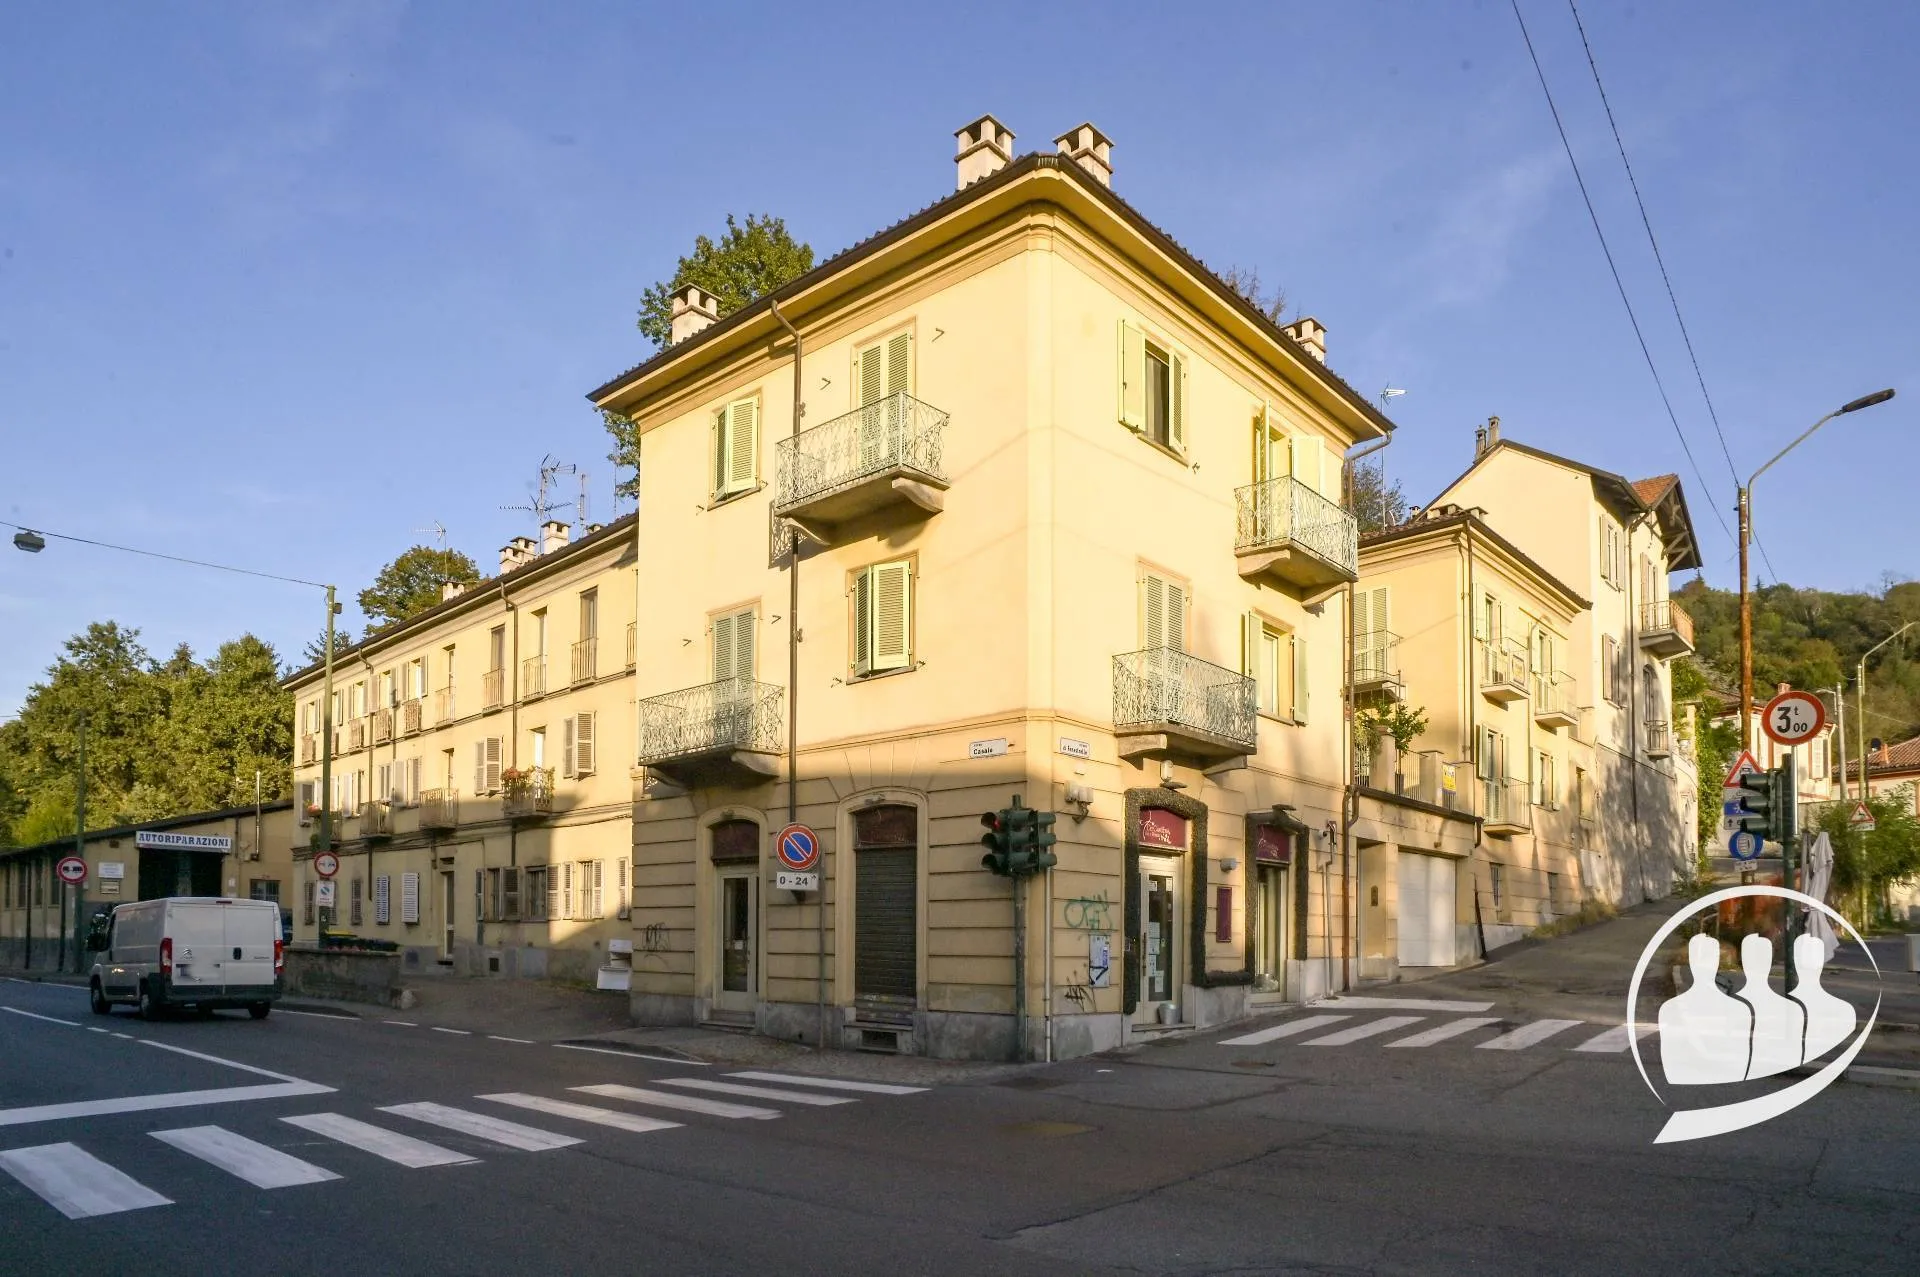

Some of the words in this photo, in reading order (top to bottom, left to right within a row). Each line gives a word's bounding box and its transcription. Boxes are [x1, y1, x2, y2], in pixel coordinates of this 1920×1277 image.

[1794, 705, 1800, 715] t
[1777, 706, 1791, 733] 3
[1793, 722, 1808, 733] 00
[973, 747, 993, 755] Casale
[138, 832, 229, 847] AUTORIPARAZIONI
[779, 875, 786, 885] 0
[795, 876, 809, 886] 24
